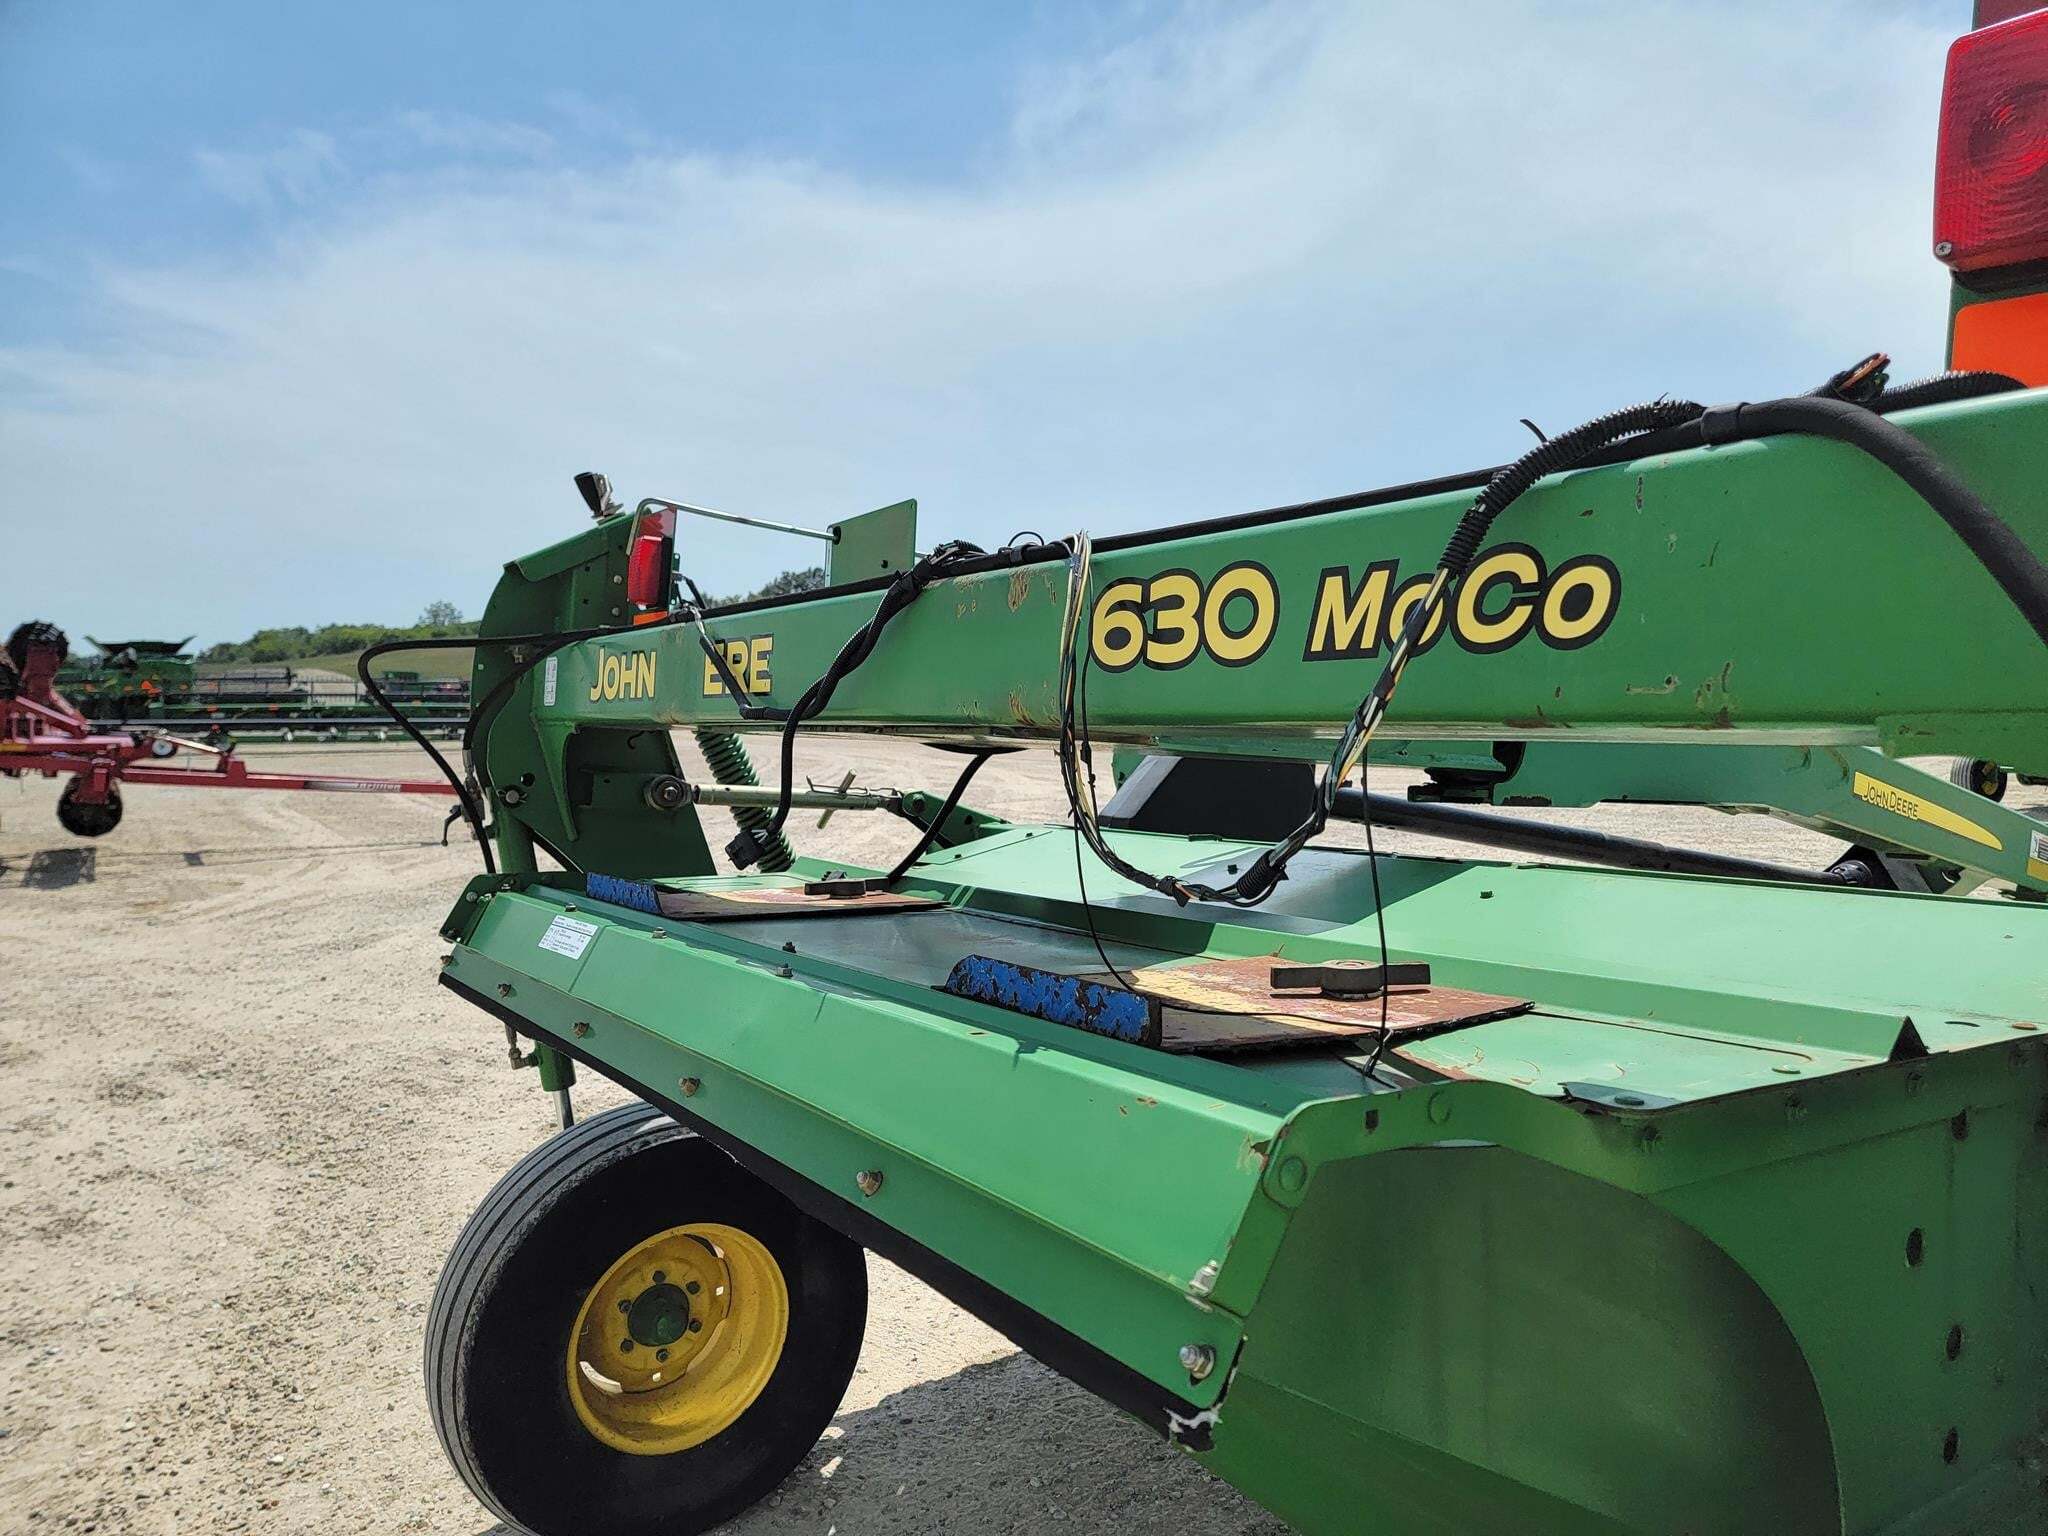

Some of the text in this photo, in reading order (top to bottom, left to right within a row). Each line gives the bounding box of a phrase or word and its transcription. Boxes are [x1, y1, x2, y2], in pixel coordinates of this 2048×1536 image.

[1090, 543, 1621, 673] 630 MoCo
[589, 647, 657, 702] JOHN
[1863, 781, 1919, 818] JOHN DEERE
